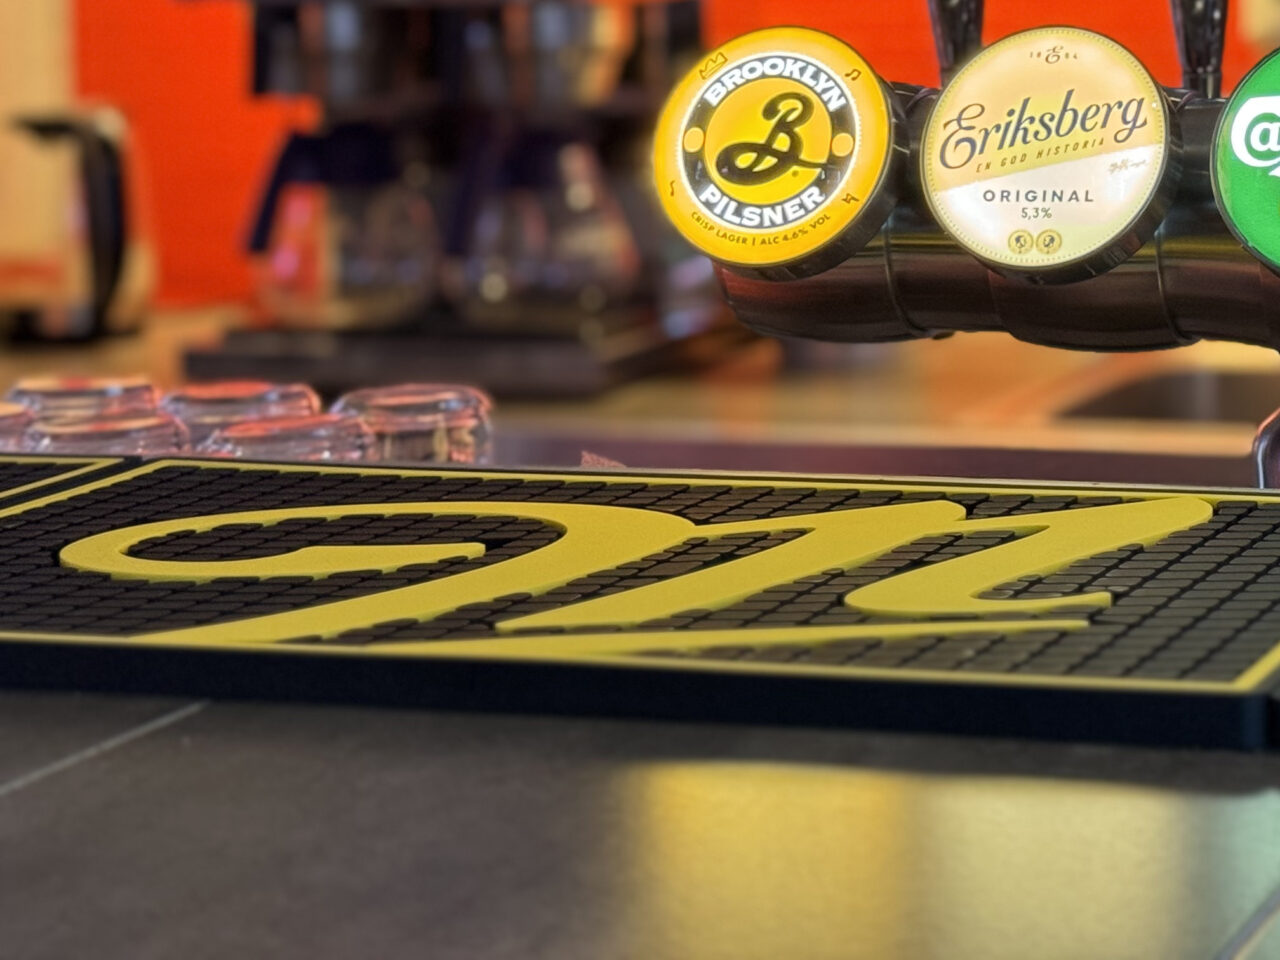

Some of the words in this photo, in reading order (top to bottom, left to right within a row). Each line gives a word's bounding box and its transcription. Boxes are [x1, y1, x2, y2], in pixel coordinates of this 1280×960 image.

[703, 57, 847, 113] BROOKLYN
[939, 89, 1148, 169] Eriksberg
[976, 162, 991, 173] EN
[1000, 153, 1027, 167] GOD
[1036, 137, 1104, 159] HISTORIA
[699, 184, 827, 228] PILSNER
[983, 190, 1094, 203] ORIGINAL
[1021, 207, 1053, 221] 5,3%
[691, 211, 715, 232] CRISP
[716, 229, 748, 246] LAGER
[760, 236, 779, 246] ALC
[809, 214, 831, 230] VOL
